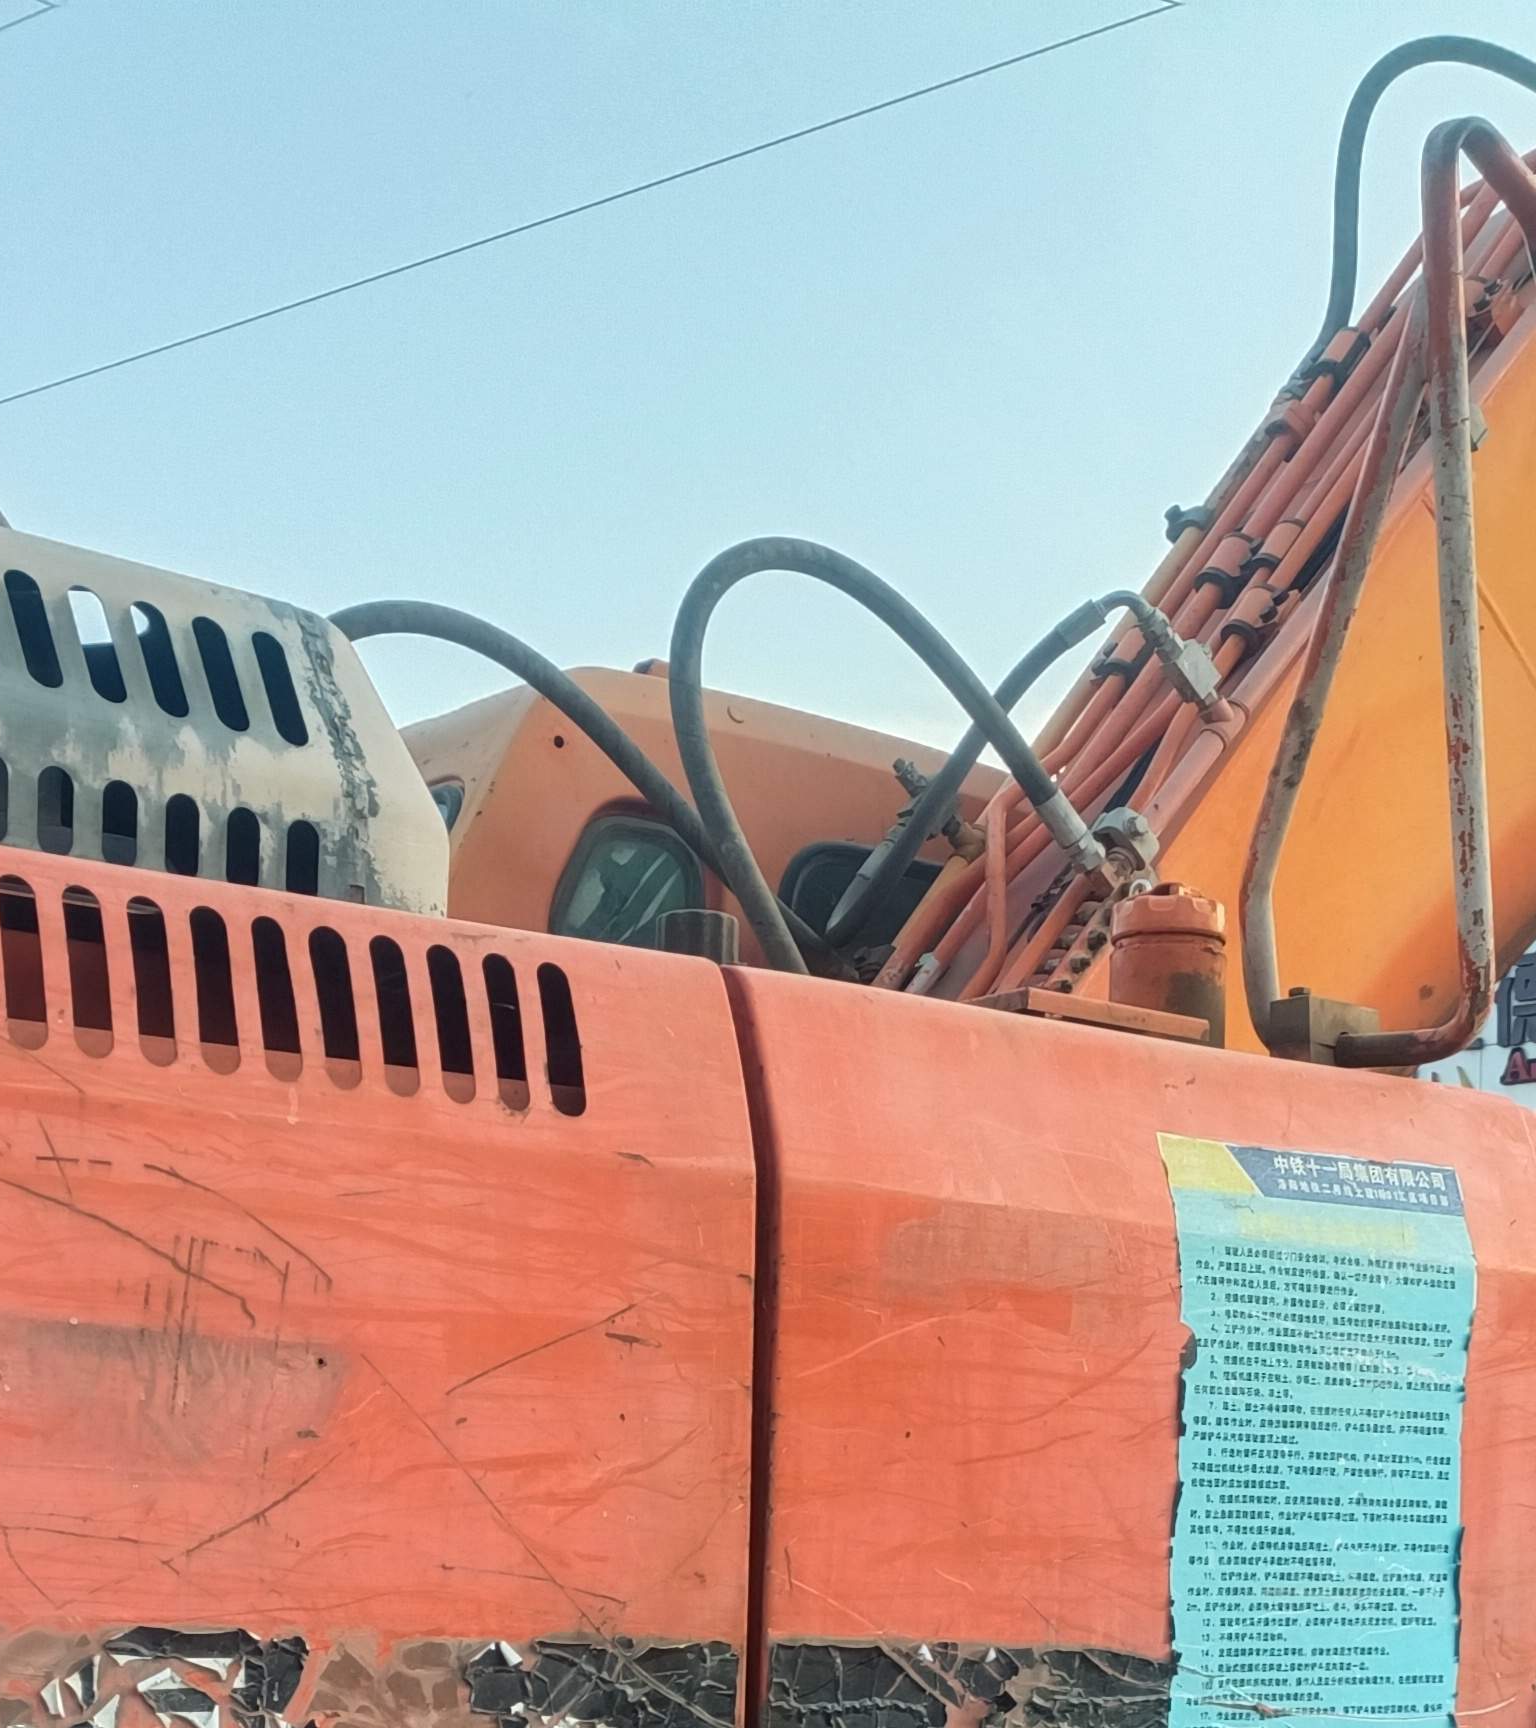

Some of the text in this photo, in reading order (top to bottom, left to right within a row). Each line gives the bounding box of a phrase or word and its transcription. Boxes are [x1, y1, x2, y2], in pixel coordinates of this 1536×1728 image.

[1273, 1154, 1446, 1191] 中铁十一局集团有限公司
